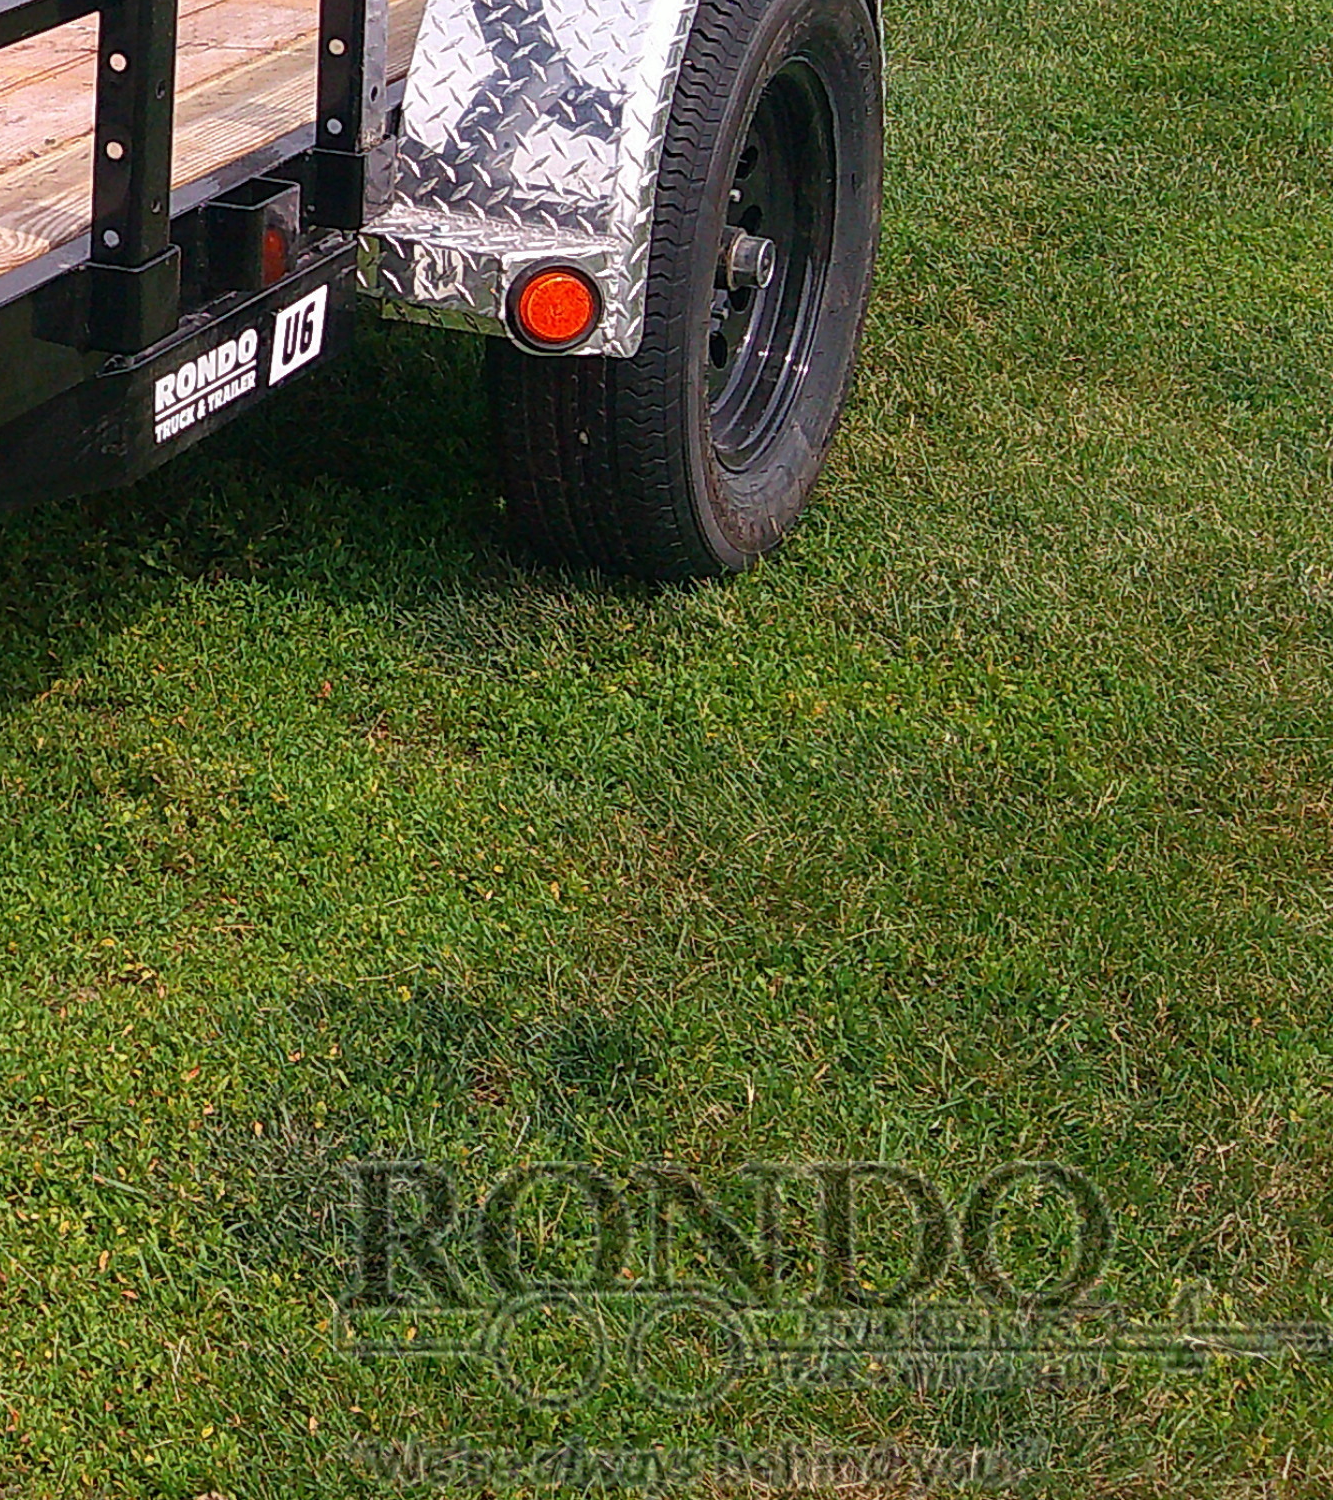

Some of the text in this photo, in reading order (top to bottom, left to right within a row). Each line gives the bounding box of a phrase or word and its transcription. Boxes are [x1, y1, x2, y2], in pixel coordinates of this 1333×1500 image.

[154, 327, 259, 415] RONDO
[282, 300, 317, 367] U6
[154, 368, 257, 444] TRUCK & TRAILER
